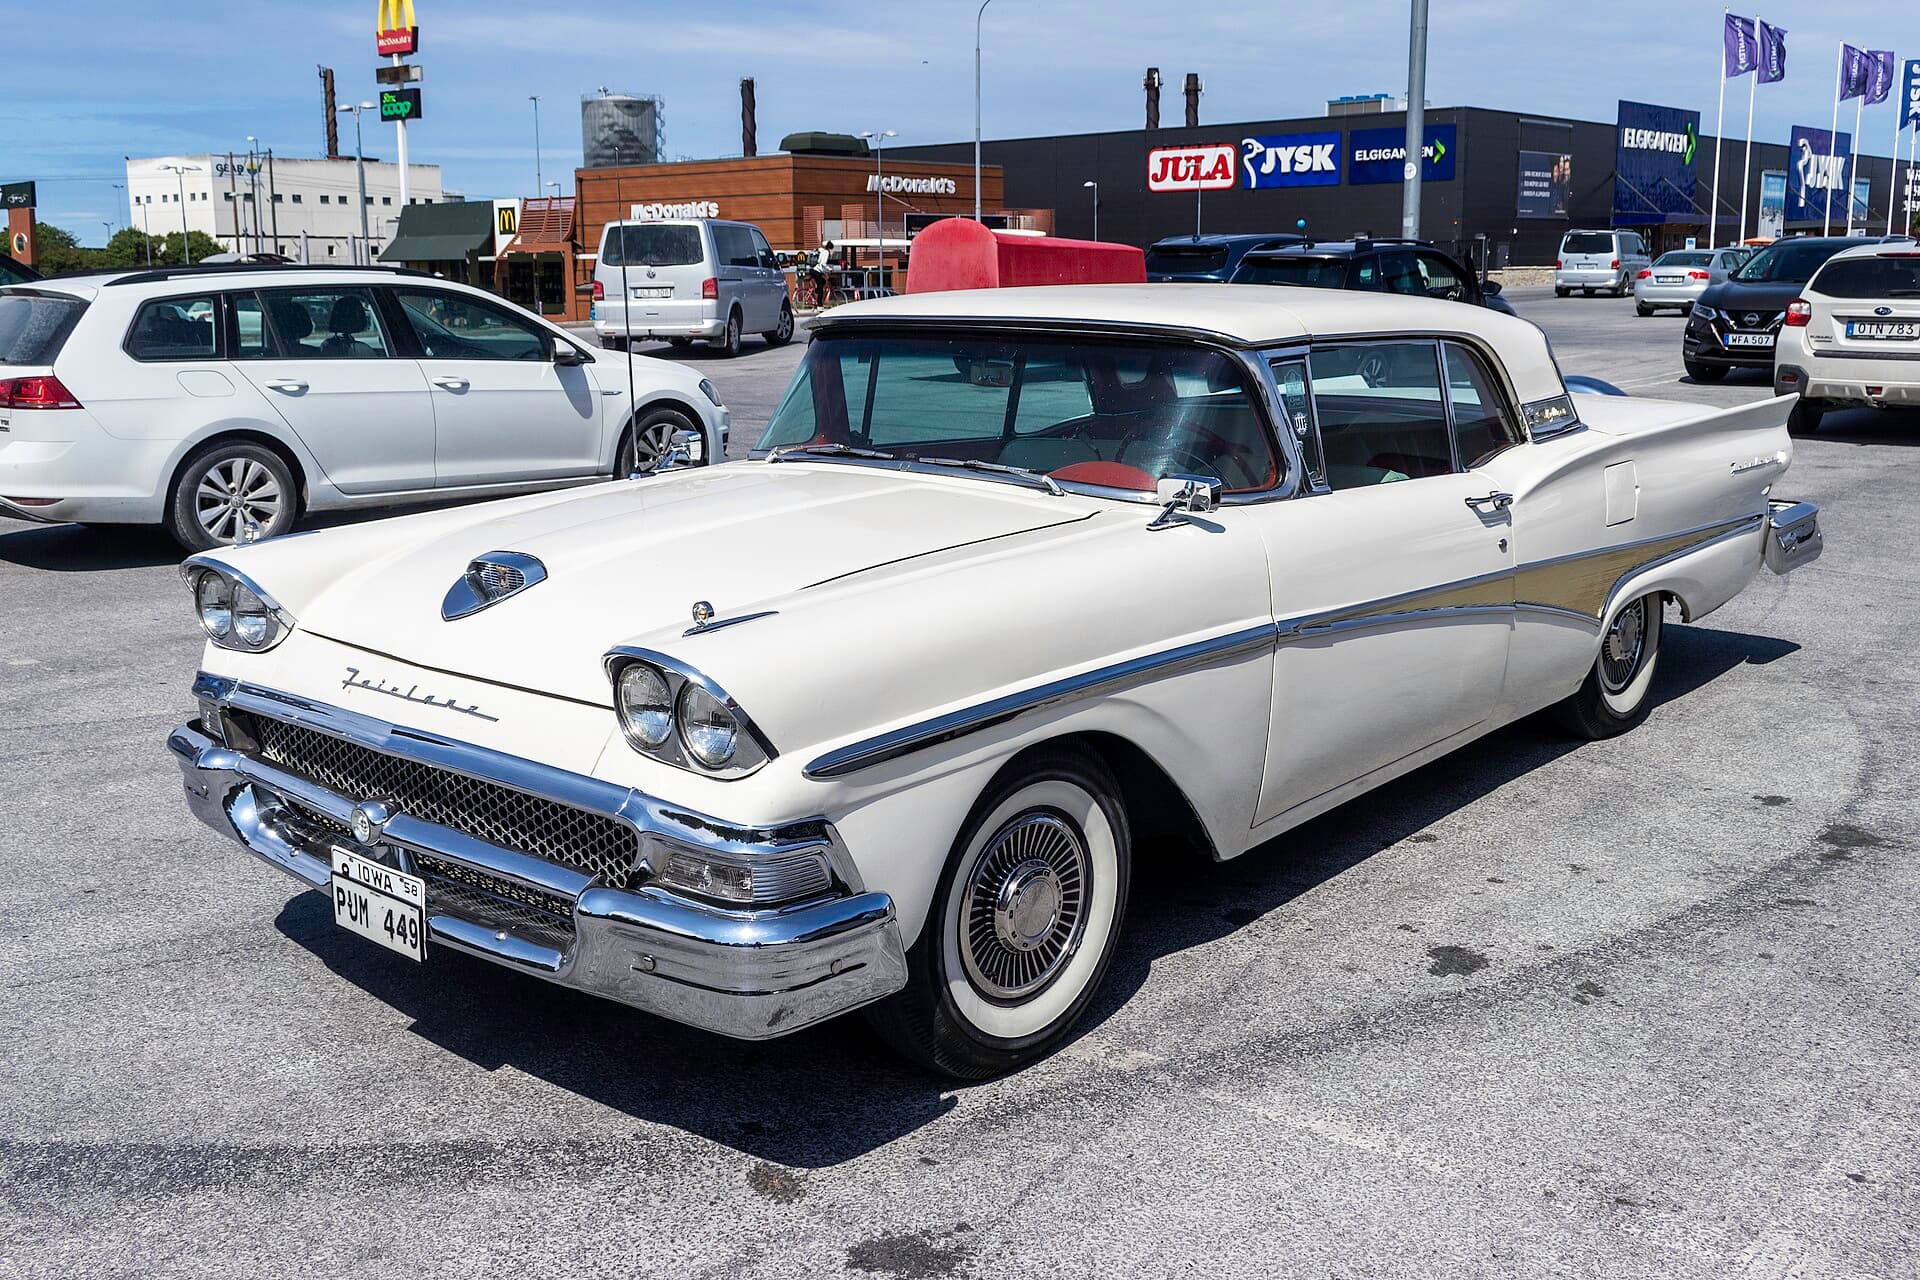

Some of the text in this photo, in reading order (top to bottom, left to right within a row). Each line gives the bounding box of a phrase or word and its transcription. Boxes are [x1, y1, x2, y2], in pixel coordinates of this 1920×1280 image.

[1260, 144, 1336, 174] JYSK
[1355, 146, 1434, 161] ELGIGANEN
[1151, 153, 1232, 182] JULA
[867, 174, 956, 195] McDonald's
[631, 201, 719, 220] McDonald's
[1731, 335, 1770, 345] WFA 507
[1858, 322, 1914, 335] OTN 783
[342, 667, 500, 722] Fairlane
[358, 863, 393, 893] IOWA
[404, 881, 418, 897] 58
[336, 886, 418, 950] PUM 449
